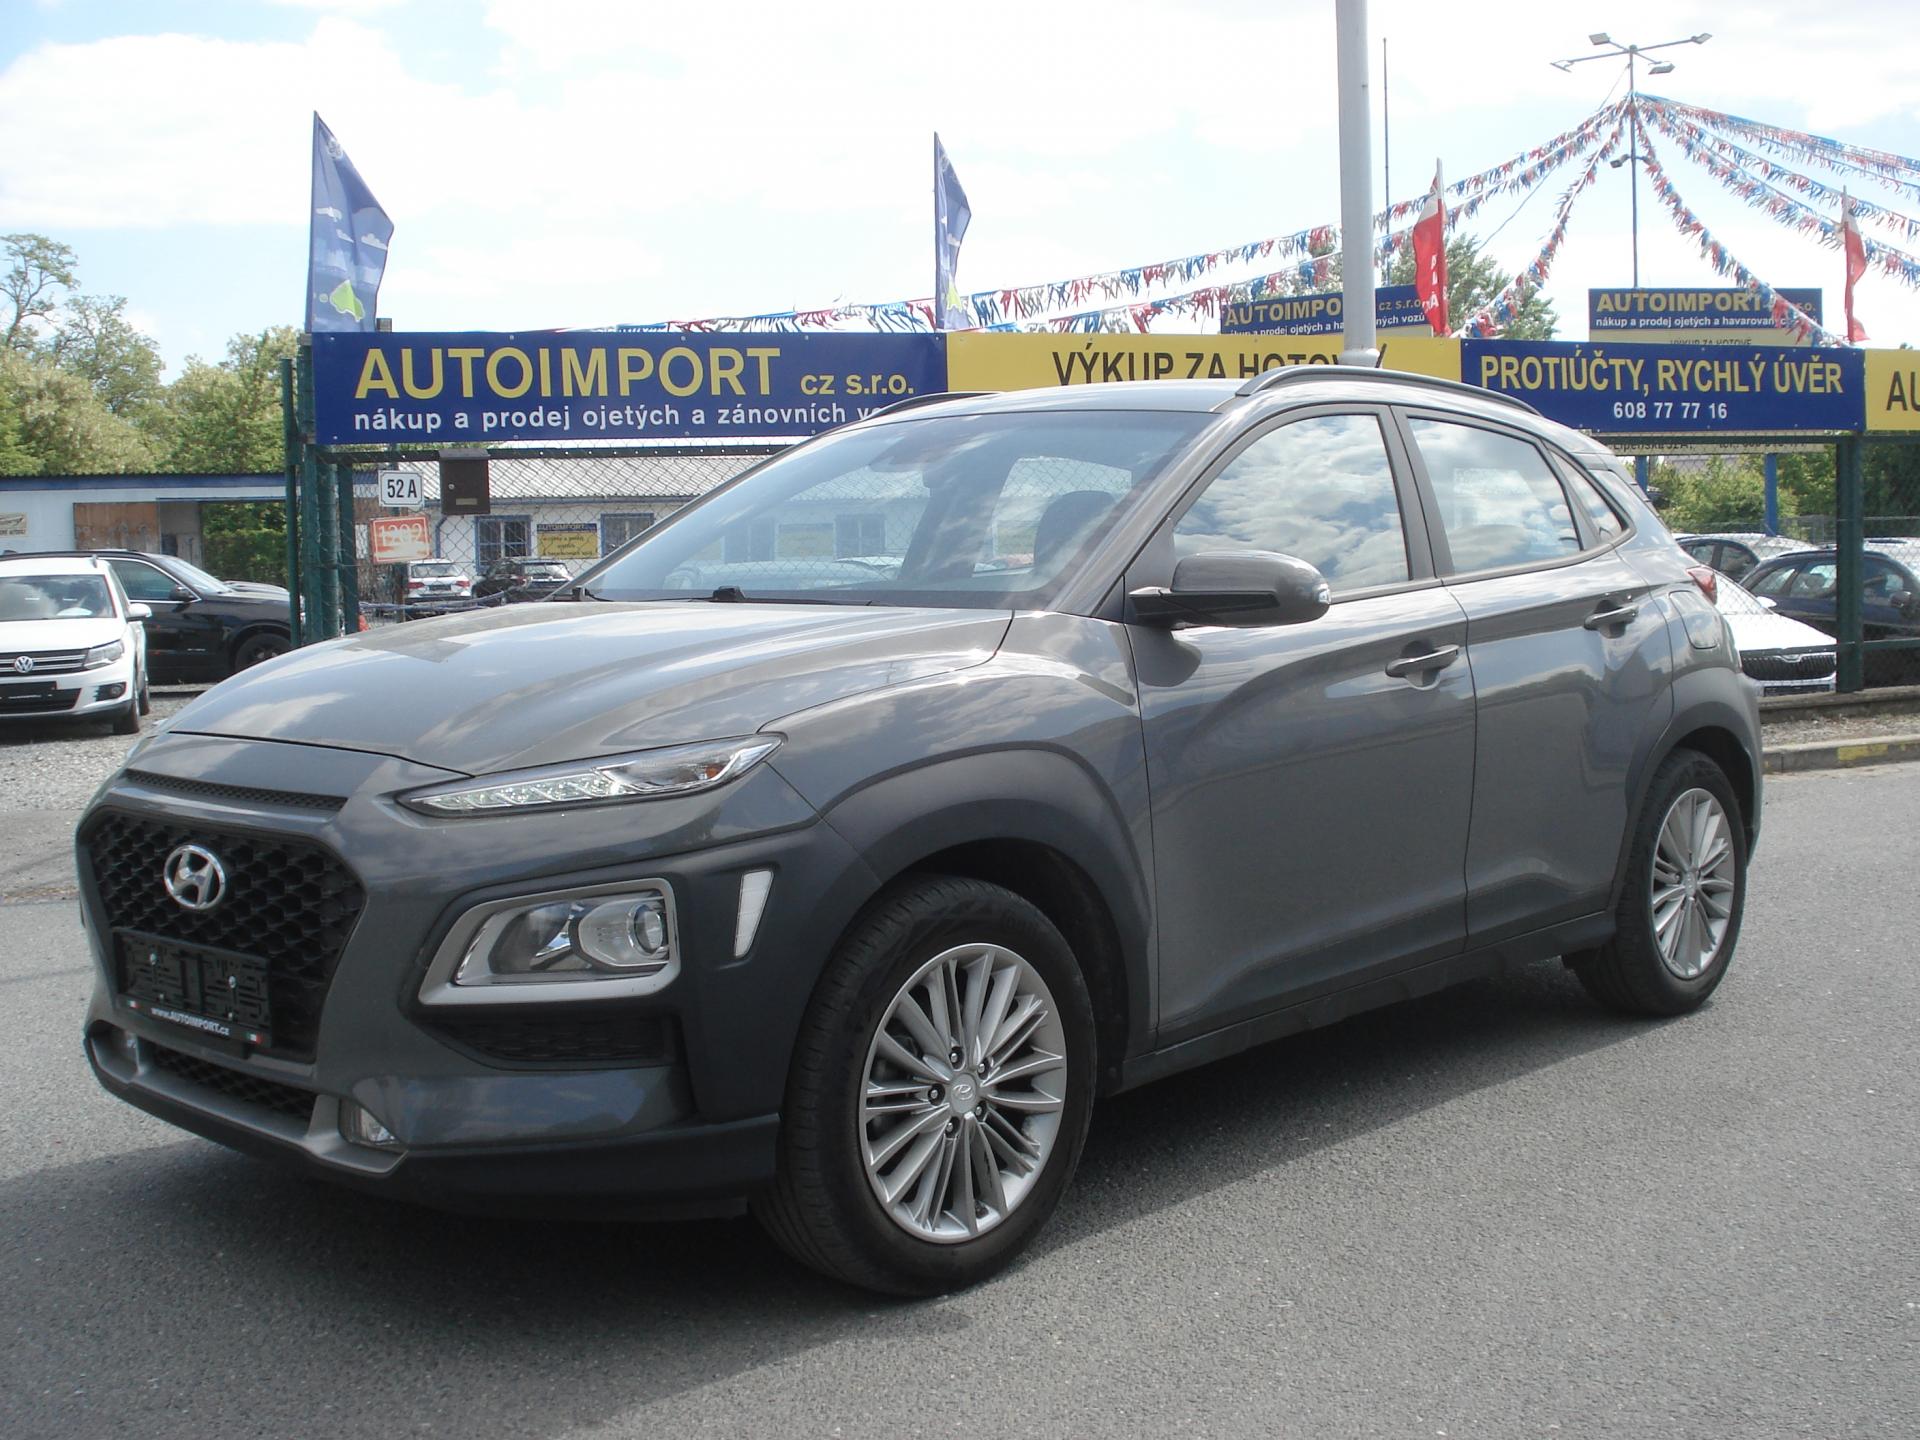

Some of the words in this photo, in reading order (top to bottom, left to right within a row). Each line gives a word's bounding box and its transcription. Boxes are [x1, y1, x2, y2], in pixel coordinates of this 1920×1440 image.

[1223, 297, 1342, 327] AUTOIMPO
[1395, 298, 1422, 310] s.r.o
[1290, 321, 1323, 335] ojetých
[1401, 312, 1426, 323] vozů
[1595, 316, 1628, 328] nákup
[1639, 316, 1672, 328] prodej
[1674, 316, 1711, 328] ojetých
[1722, 316, 1788, 326] havarovanc
[354, 346, 781, 400] AUTOIMPORT
[800, 374, 835, 395] cz
[846, 373, 914, 395] s.r.o.
[1052, 342, 1174, 386] VÝKUP
[1480, 350, 1649, 397] PROTIÚČTY,
[1657, 353, 1766, 393] RYCHLÝ
[1773, 354, 1844, 394] ÚVĚR
[354, 407, 442, 433] nákup
[454, 412, 469, 428] a
[482, 405, 570, 432] prodej
[582, 403, 680, 430] ojetých
[691, 408, 705, 425] a
[717, 402, 846, 425] zánovních
[1613, 402, 1646, 419] 608
[1653, 402, 1673, 419] 77
[1681, 402, 1701, 419] 77
[1709, 402, 1728, 419] 16
